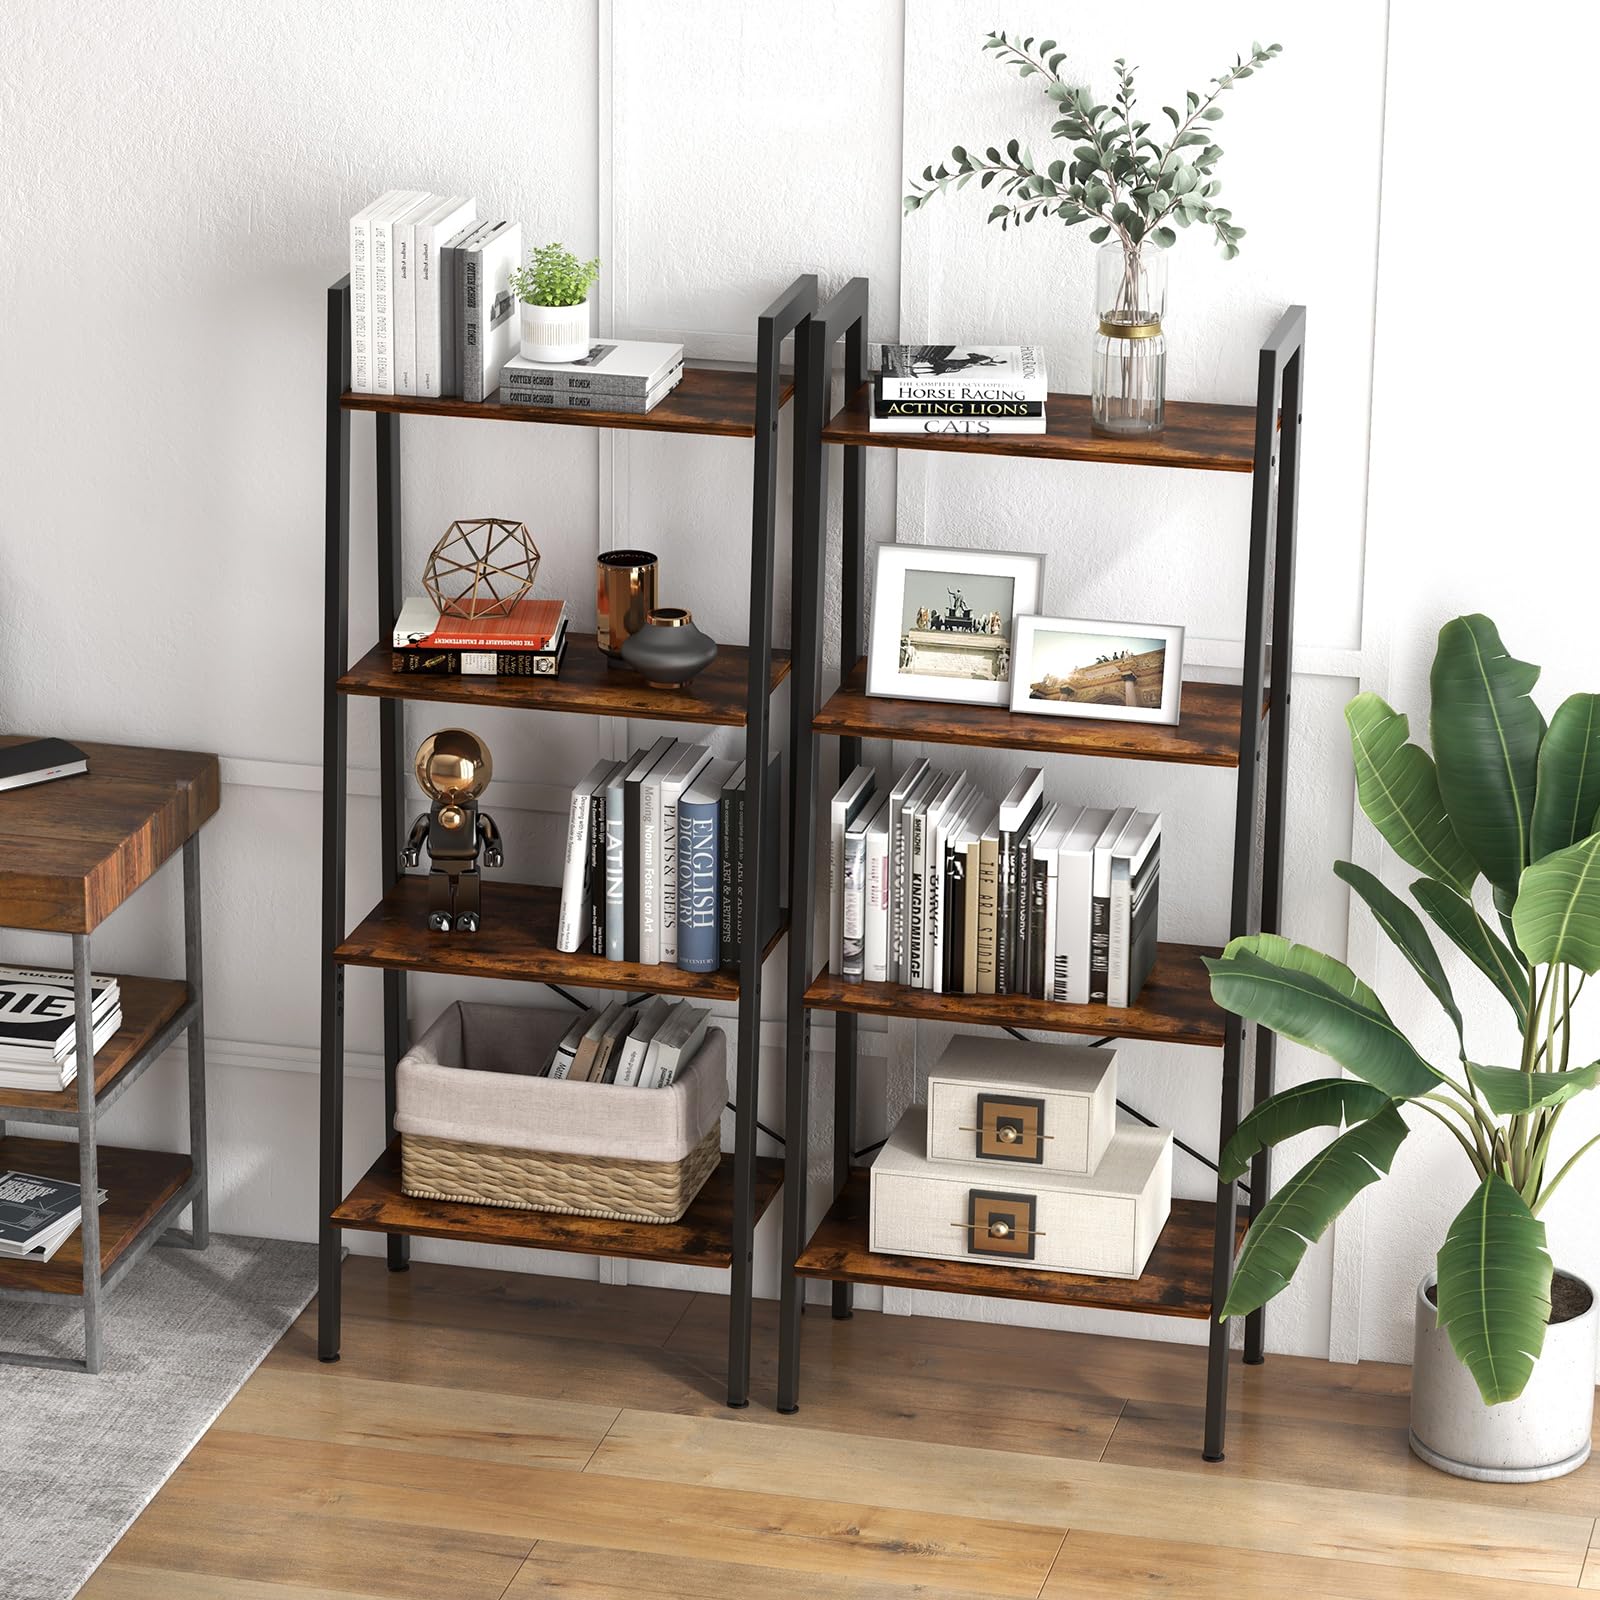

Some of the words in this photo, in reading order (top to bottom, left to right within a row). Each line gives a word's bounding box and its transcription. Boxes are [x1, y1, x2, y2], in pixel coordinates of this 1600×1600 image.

[899, 387, 955, 399] HORSE
[961, 388, 1026, 401] RACING
[887, 403, 964, 415] ACTING
[970, 403, 1028, 415] LIONS
[924, 420, 990, 434] CATS
[643, 786, 654, 822] Moving
[664, 805, 677, 863] PLANTS
[722, 810, 730, 836] complete
[644, 825, 655, 866] Norman
[722, 836, 731, 852] guide
[914, 818, 922, 856] SHENZHEN
[644, 868, 655, 900] Foster
[664, 865, 677, 877] &
[679, 816, 692, 928] DICTIONARY
[692, 818, 714, 929] ENGLISH
[722, 860, 731, 884] ART
[979, 862, 994, 884] THE
[722, 885, 731, 895] &
[644, 902, 653, 915] on
[664, 881, 676, 929] TREES
[978, 895, 993, 917] ART
[644, 917, 655, 933] Art
[722, 896, 731, 943] ARTISTS
[911, 873, 922, 979] KINGDOMIMAGE
[977, 927, 993, 974] STUDIO
